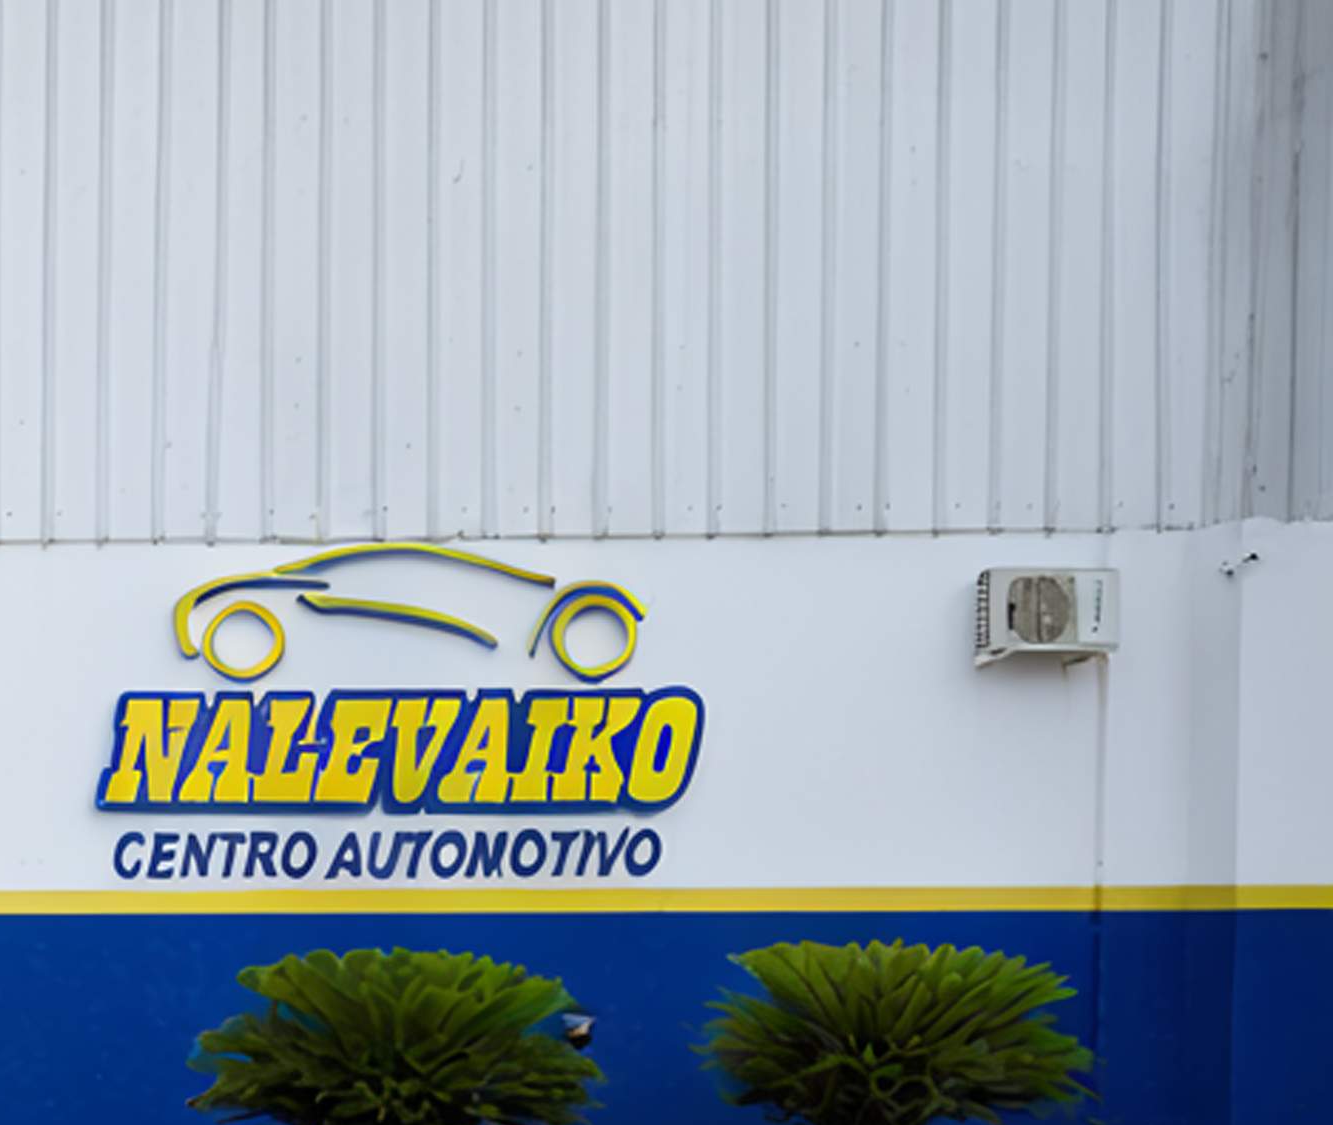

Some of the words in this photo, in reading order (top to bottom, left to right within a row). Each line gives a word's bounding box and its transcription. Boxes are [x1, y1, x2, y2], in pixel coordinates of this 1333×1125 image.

[97, 688, 704, 813] NALEVAIKO
[113, 830, 318, 879] CENTRO
[325, 827, 662, 879] AUTOMOTIVO
